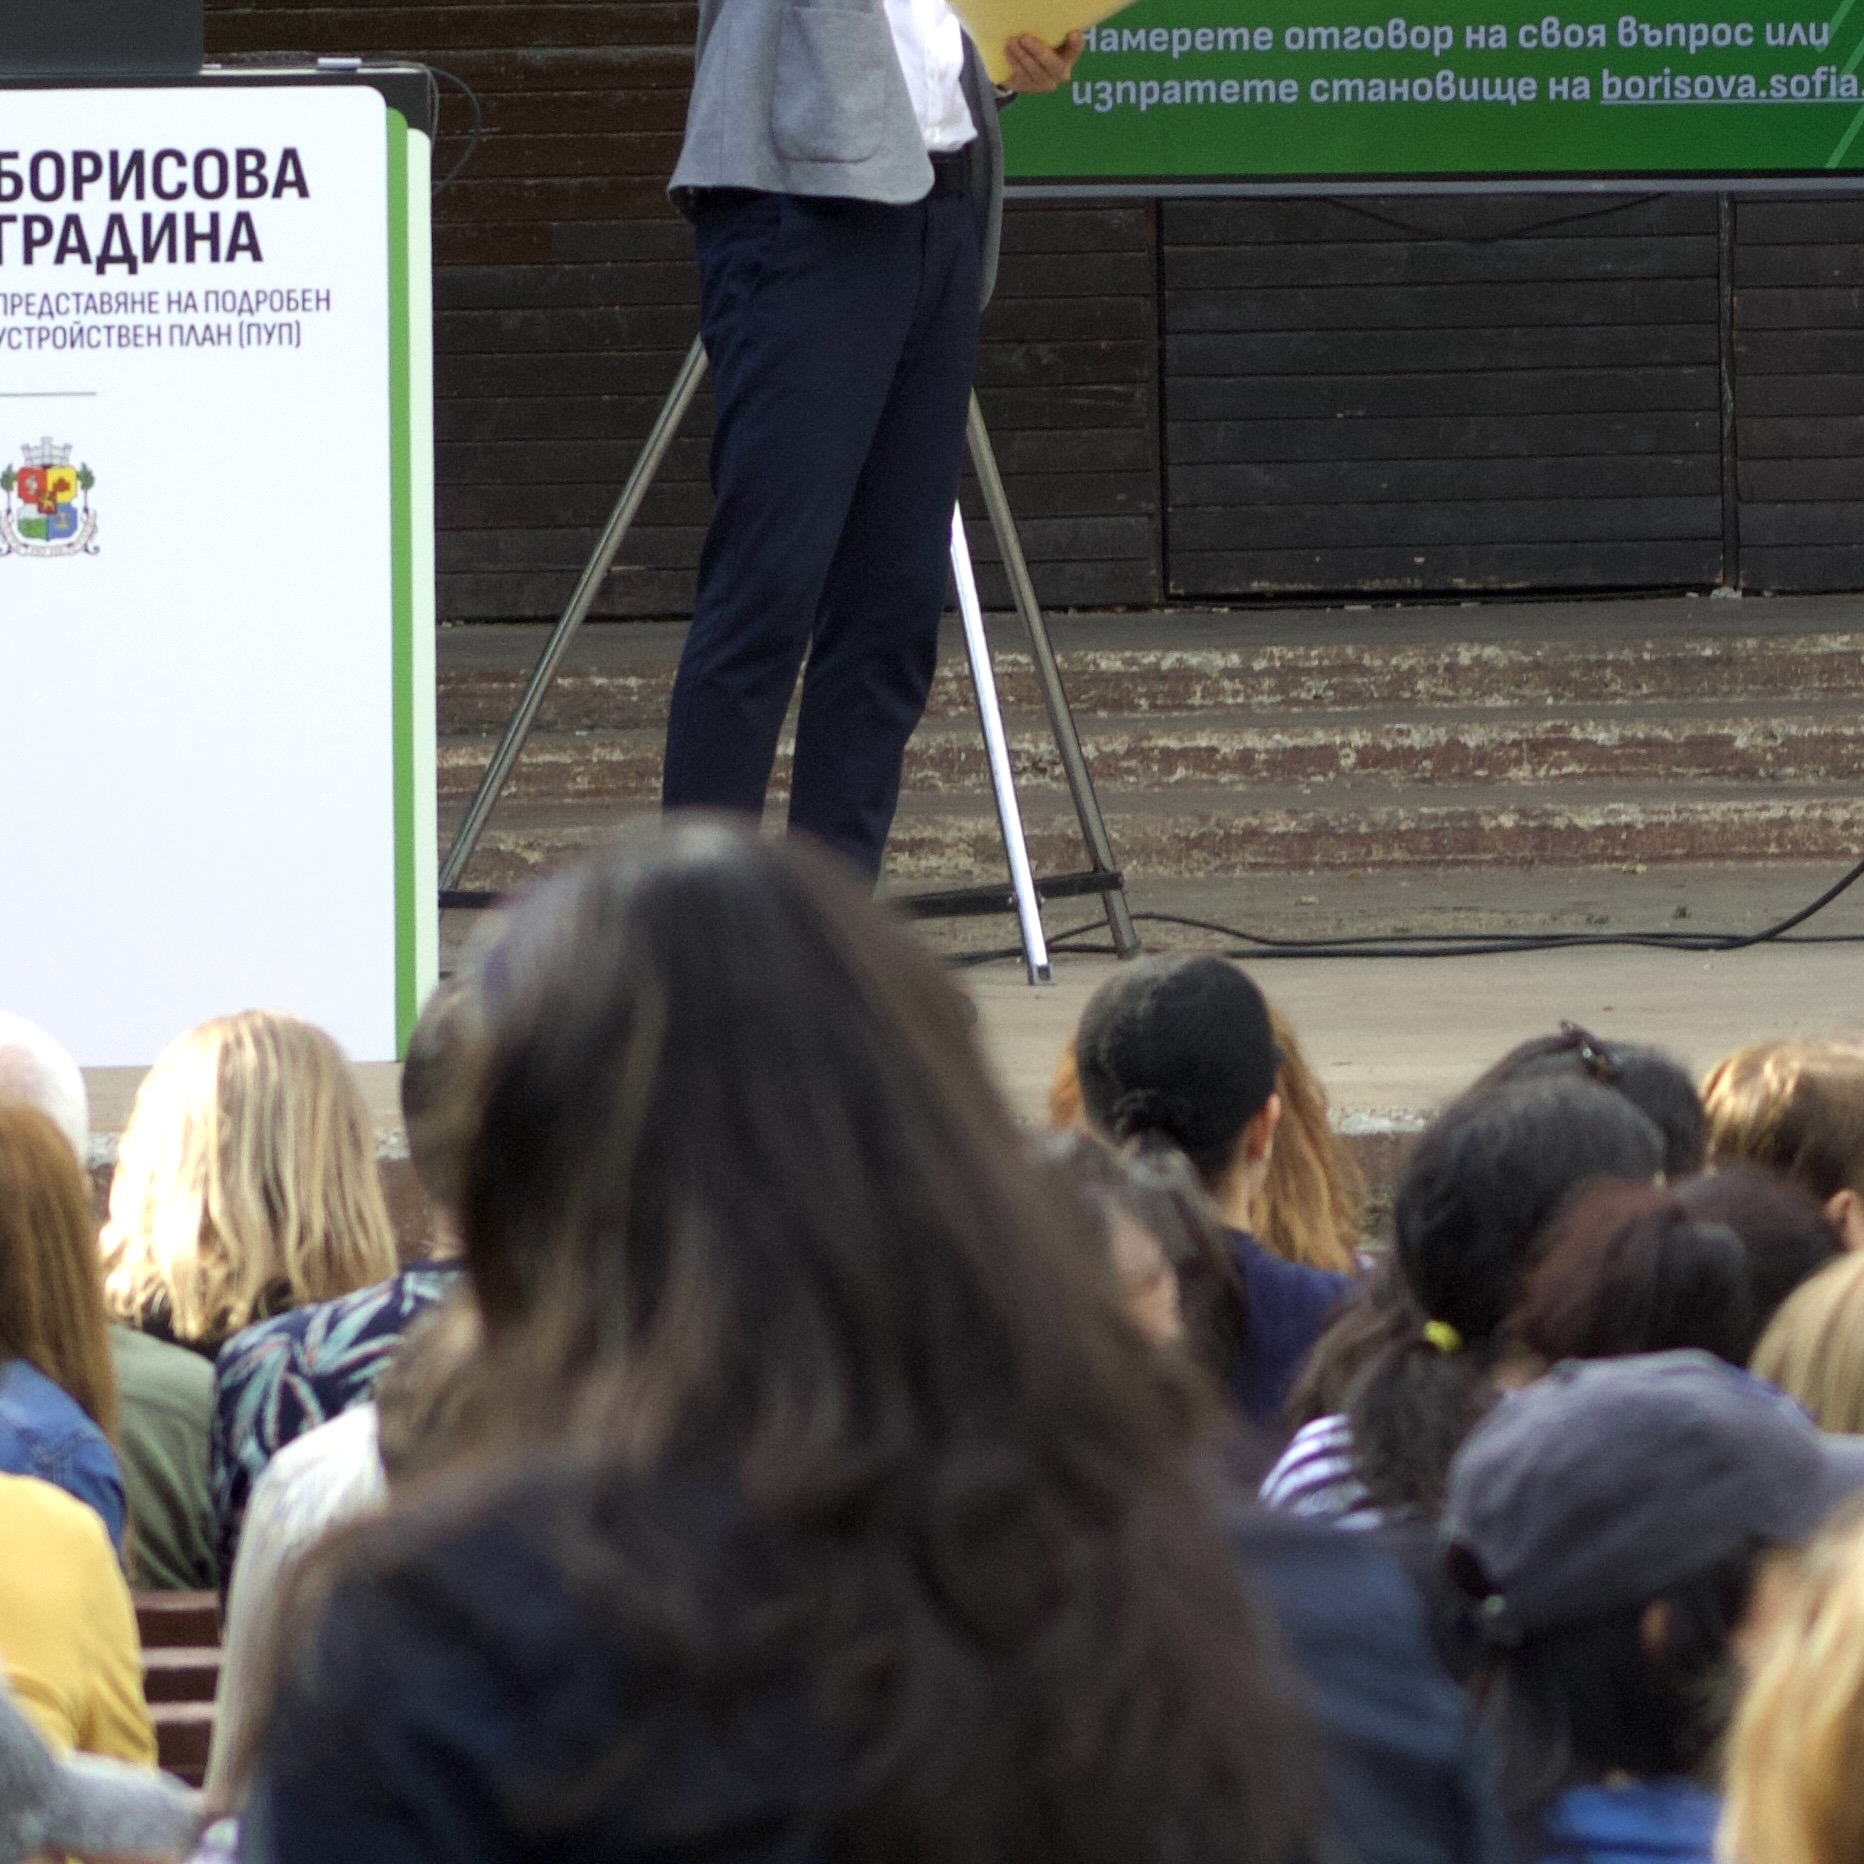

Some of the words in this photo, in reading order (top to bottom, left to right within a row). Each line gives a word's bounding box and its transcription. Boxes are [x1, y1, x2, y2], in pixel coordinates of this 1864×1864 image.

[1285, 18, 1453, 56] отговор
[1465, 25, 1507, 49] на
[1518, 16, 1606, 49] своя
[1617, 16, 1753, 54] въпрос
[1766, 23, 1830, 47] или
[1072, 79, 1299, 112] изпратете
[1309, 69, 1537, 105] становище
[1549, 77, 1590, 100] на
[0, 148, 309, 202] БОРИСОВА
[0, 211, 263, 275] ГРАДИНА
[168, 291, 198, 313] НА
[205, 289, 330, 316] ПОДРОБЕН
[170, 324, 231, 346] ПЛАН
[239, 320, 300, 348] (ПУП)
